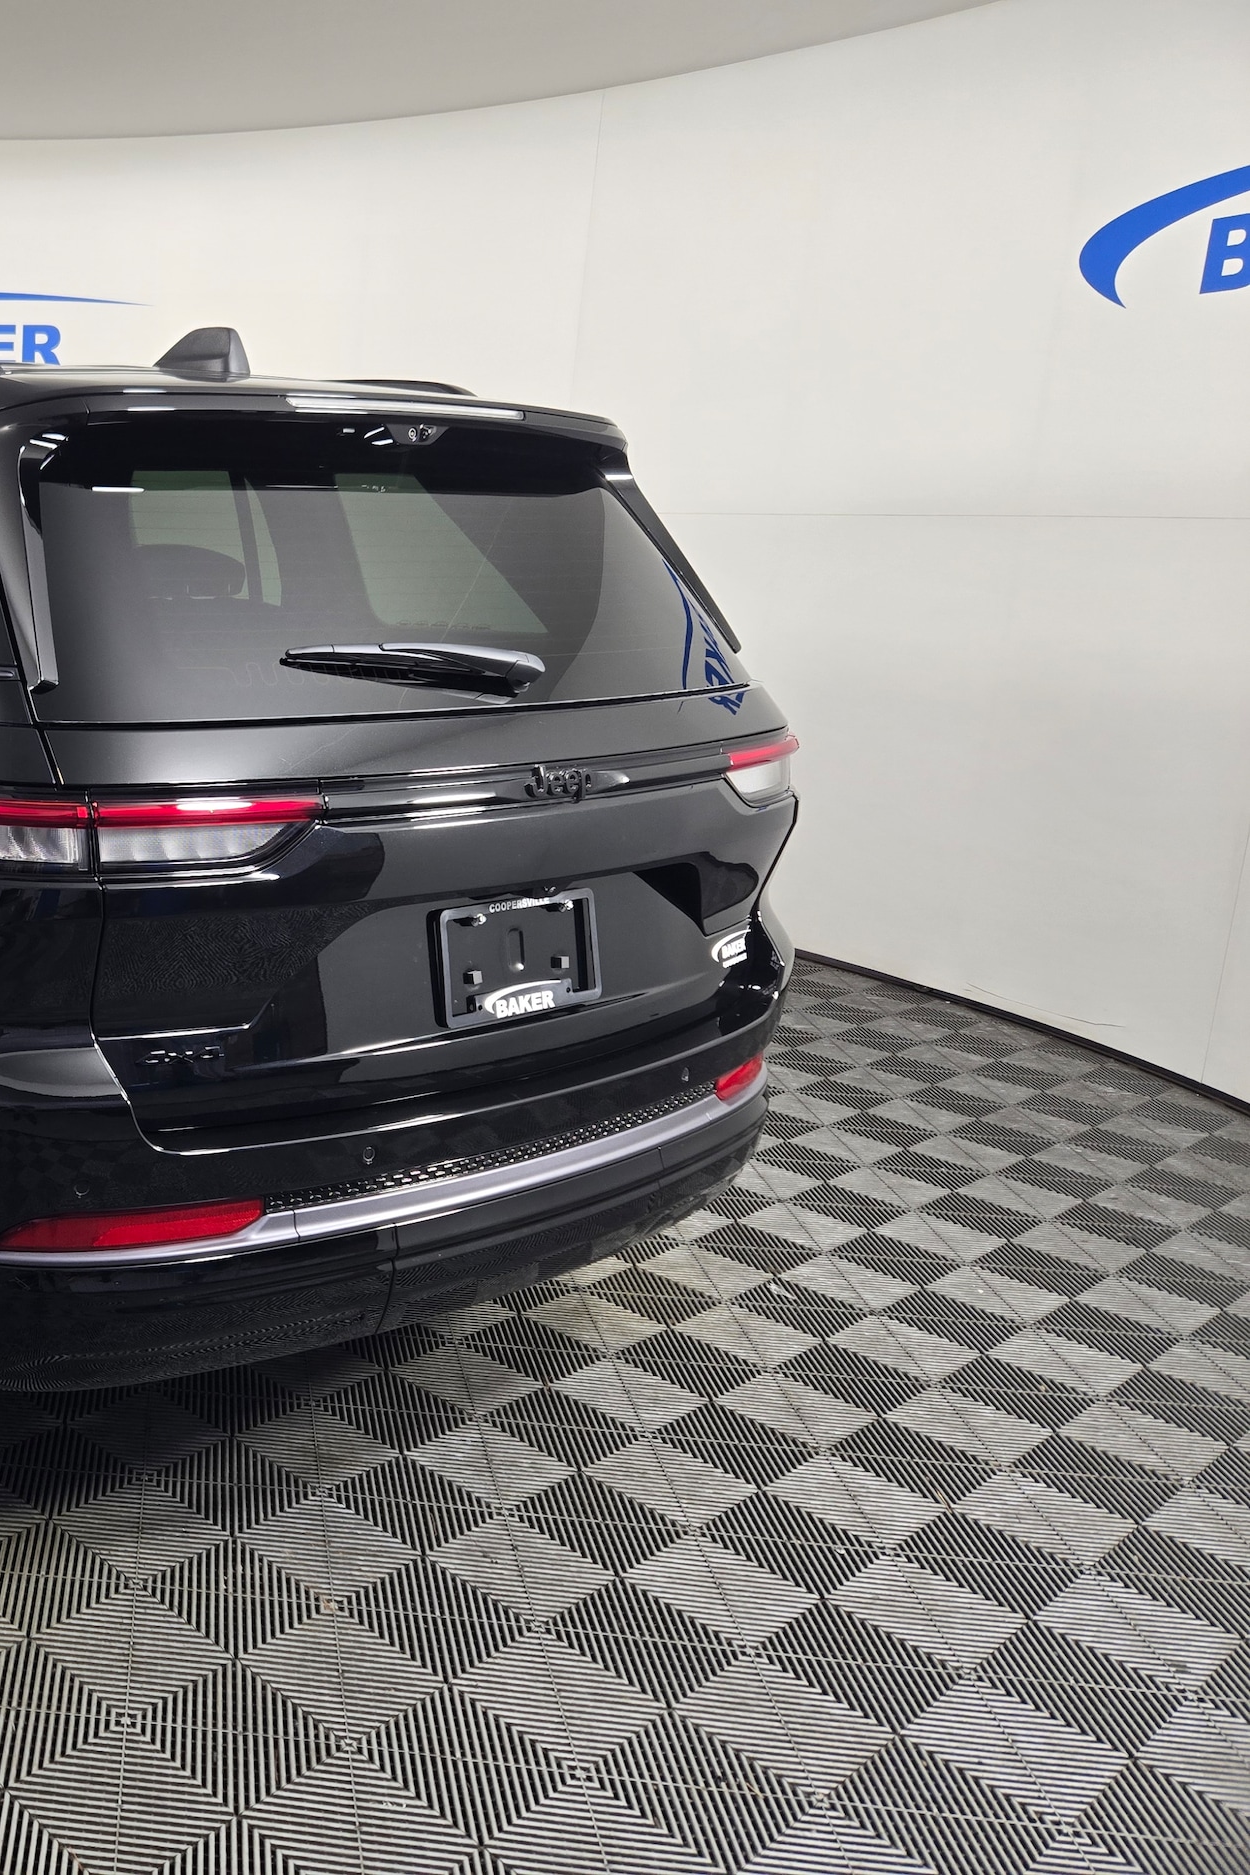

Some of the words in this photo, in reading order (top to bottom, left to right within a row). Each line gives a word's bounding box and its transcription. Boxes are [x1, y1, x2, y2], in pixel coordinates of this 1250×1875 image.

[524, 764, 591, 801] Jeep
[489, 897, 550, 913] COOPERSVILLE
[495, 990, 555, 1018] BAKER
